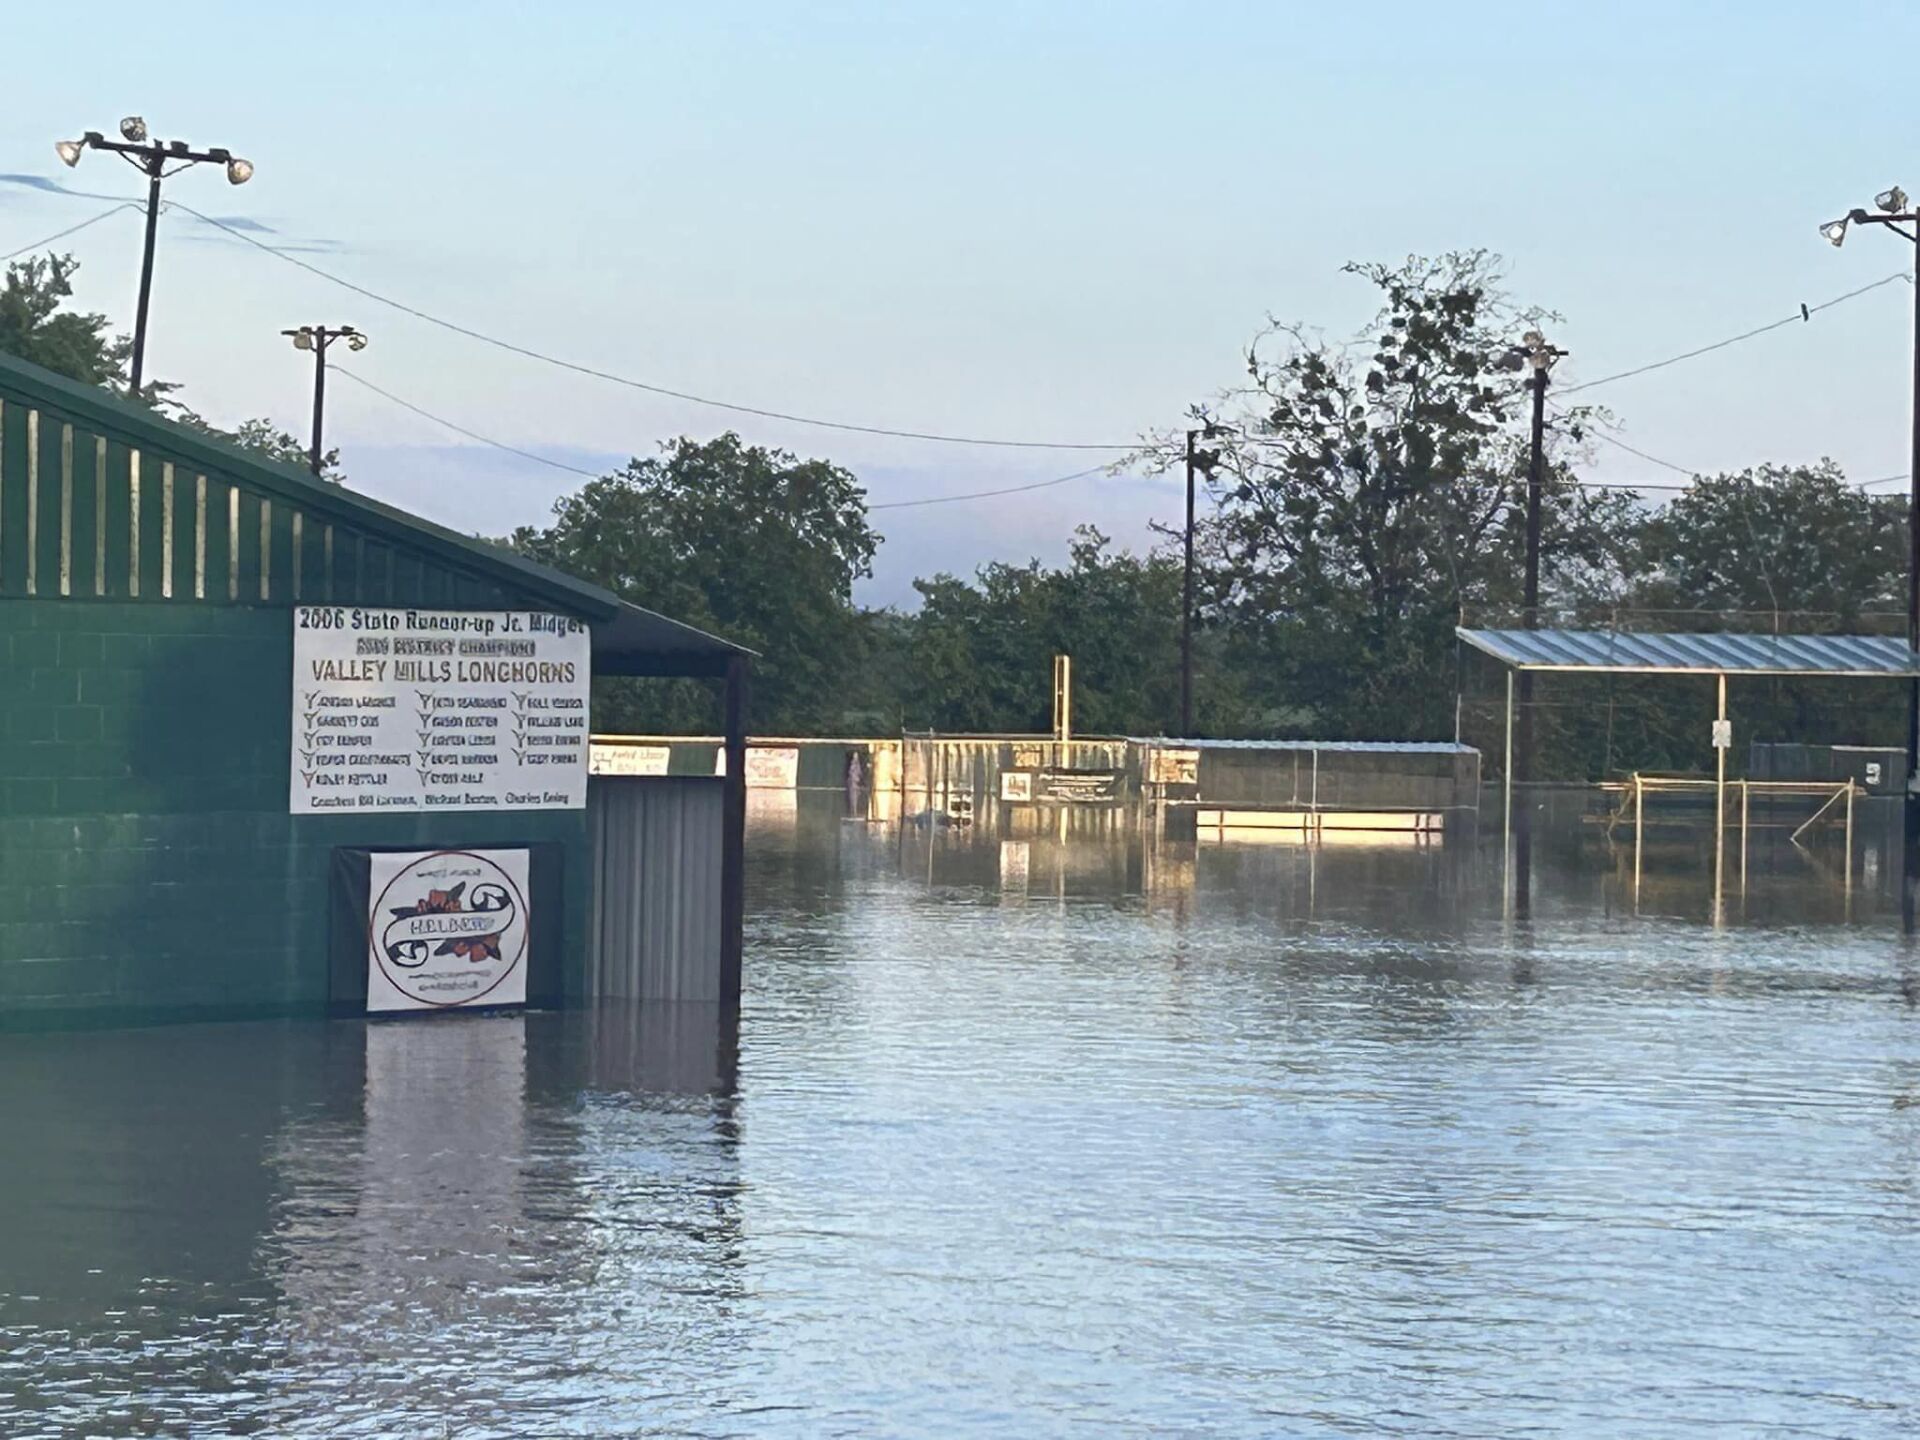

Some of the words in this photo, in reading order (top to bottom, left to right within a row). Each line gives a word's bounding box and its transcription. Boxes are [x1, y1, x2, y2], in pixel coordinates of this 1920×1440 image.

[312, 659, 388, 682] VALLEY
[394, 660, 451, 683] MILLS
[457, 661, 576, 684] LONGHORNS
